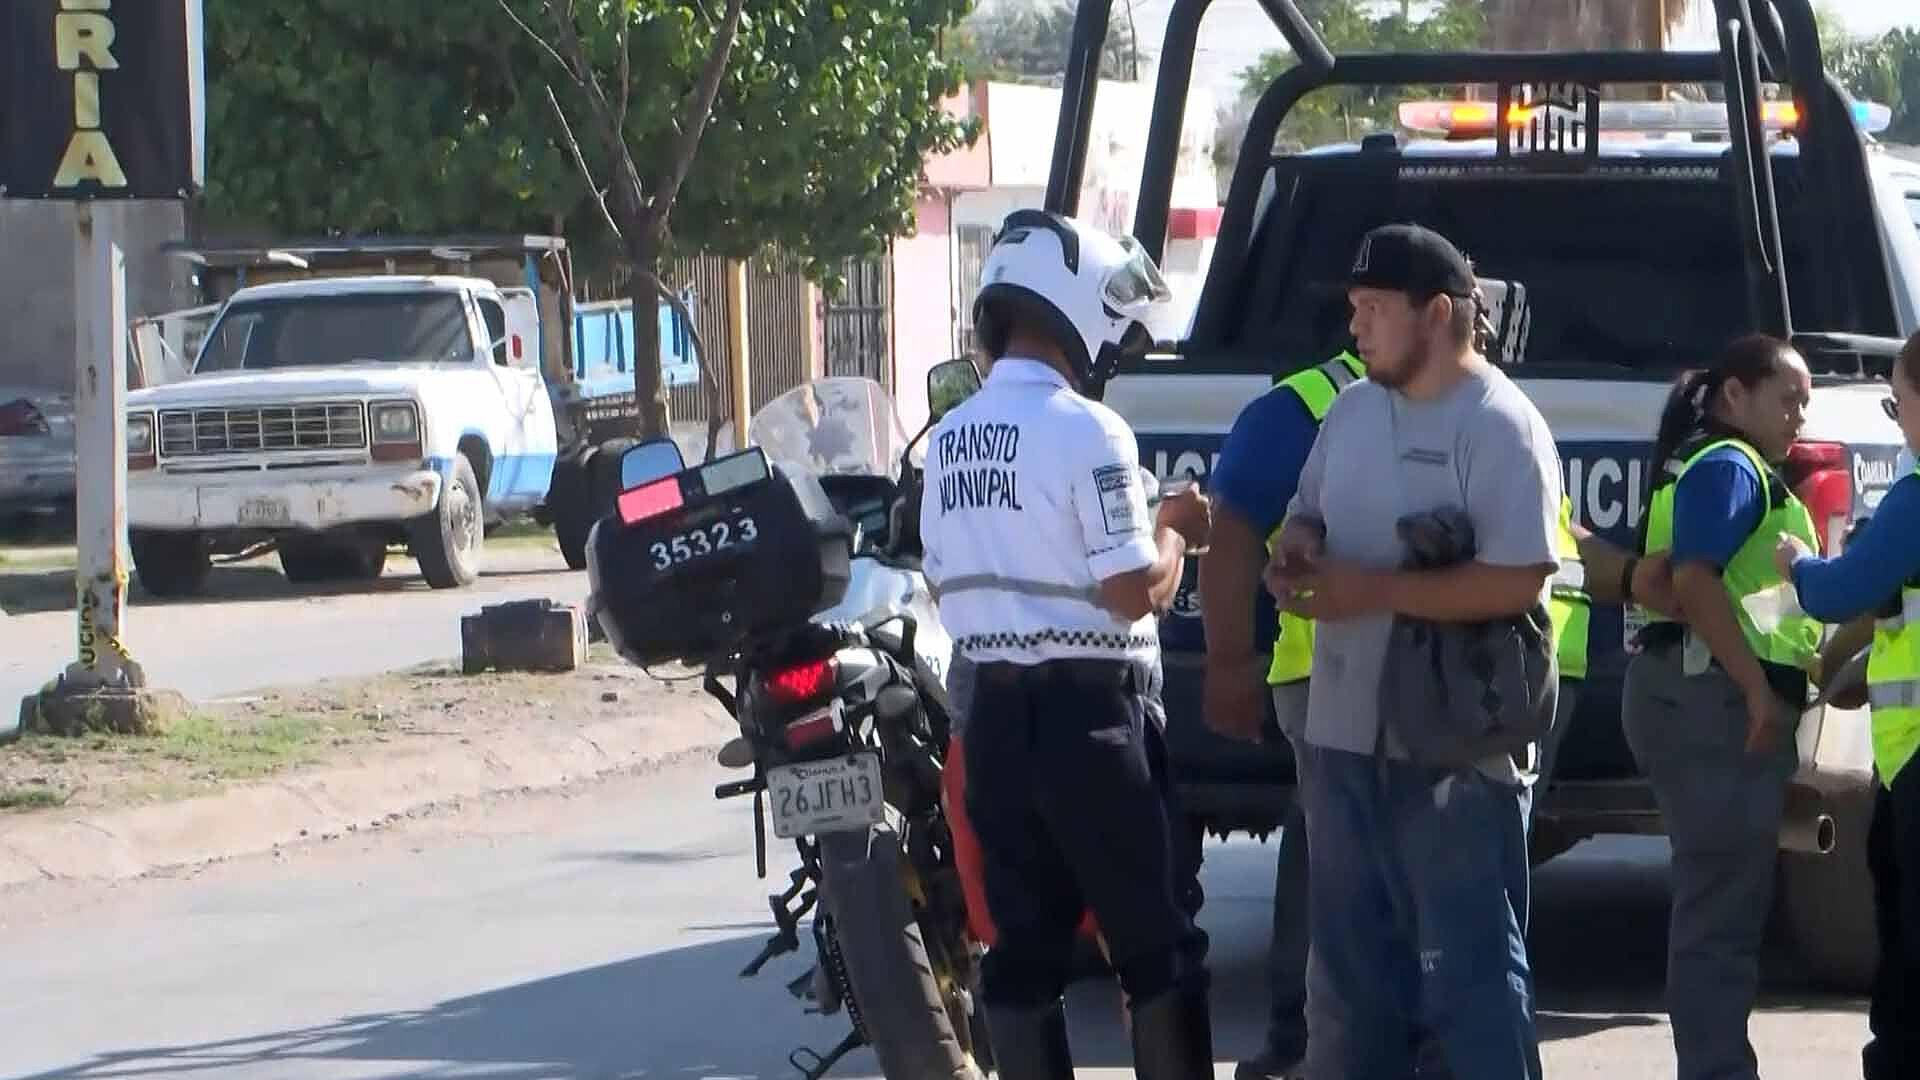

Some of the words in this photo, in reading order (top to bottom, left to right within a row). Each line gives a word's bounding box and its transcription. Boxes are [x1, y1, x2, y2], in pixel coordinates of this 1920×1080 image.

[53, 0, 128, 188] RIA
[939, 421, 1019, 470] TRANSITO
[649, 517, 758, 571] 35323
